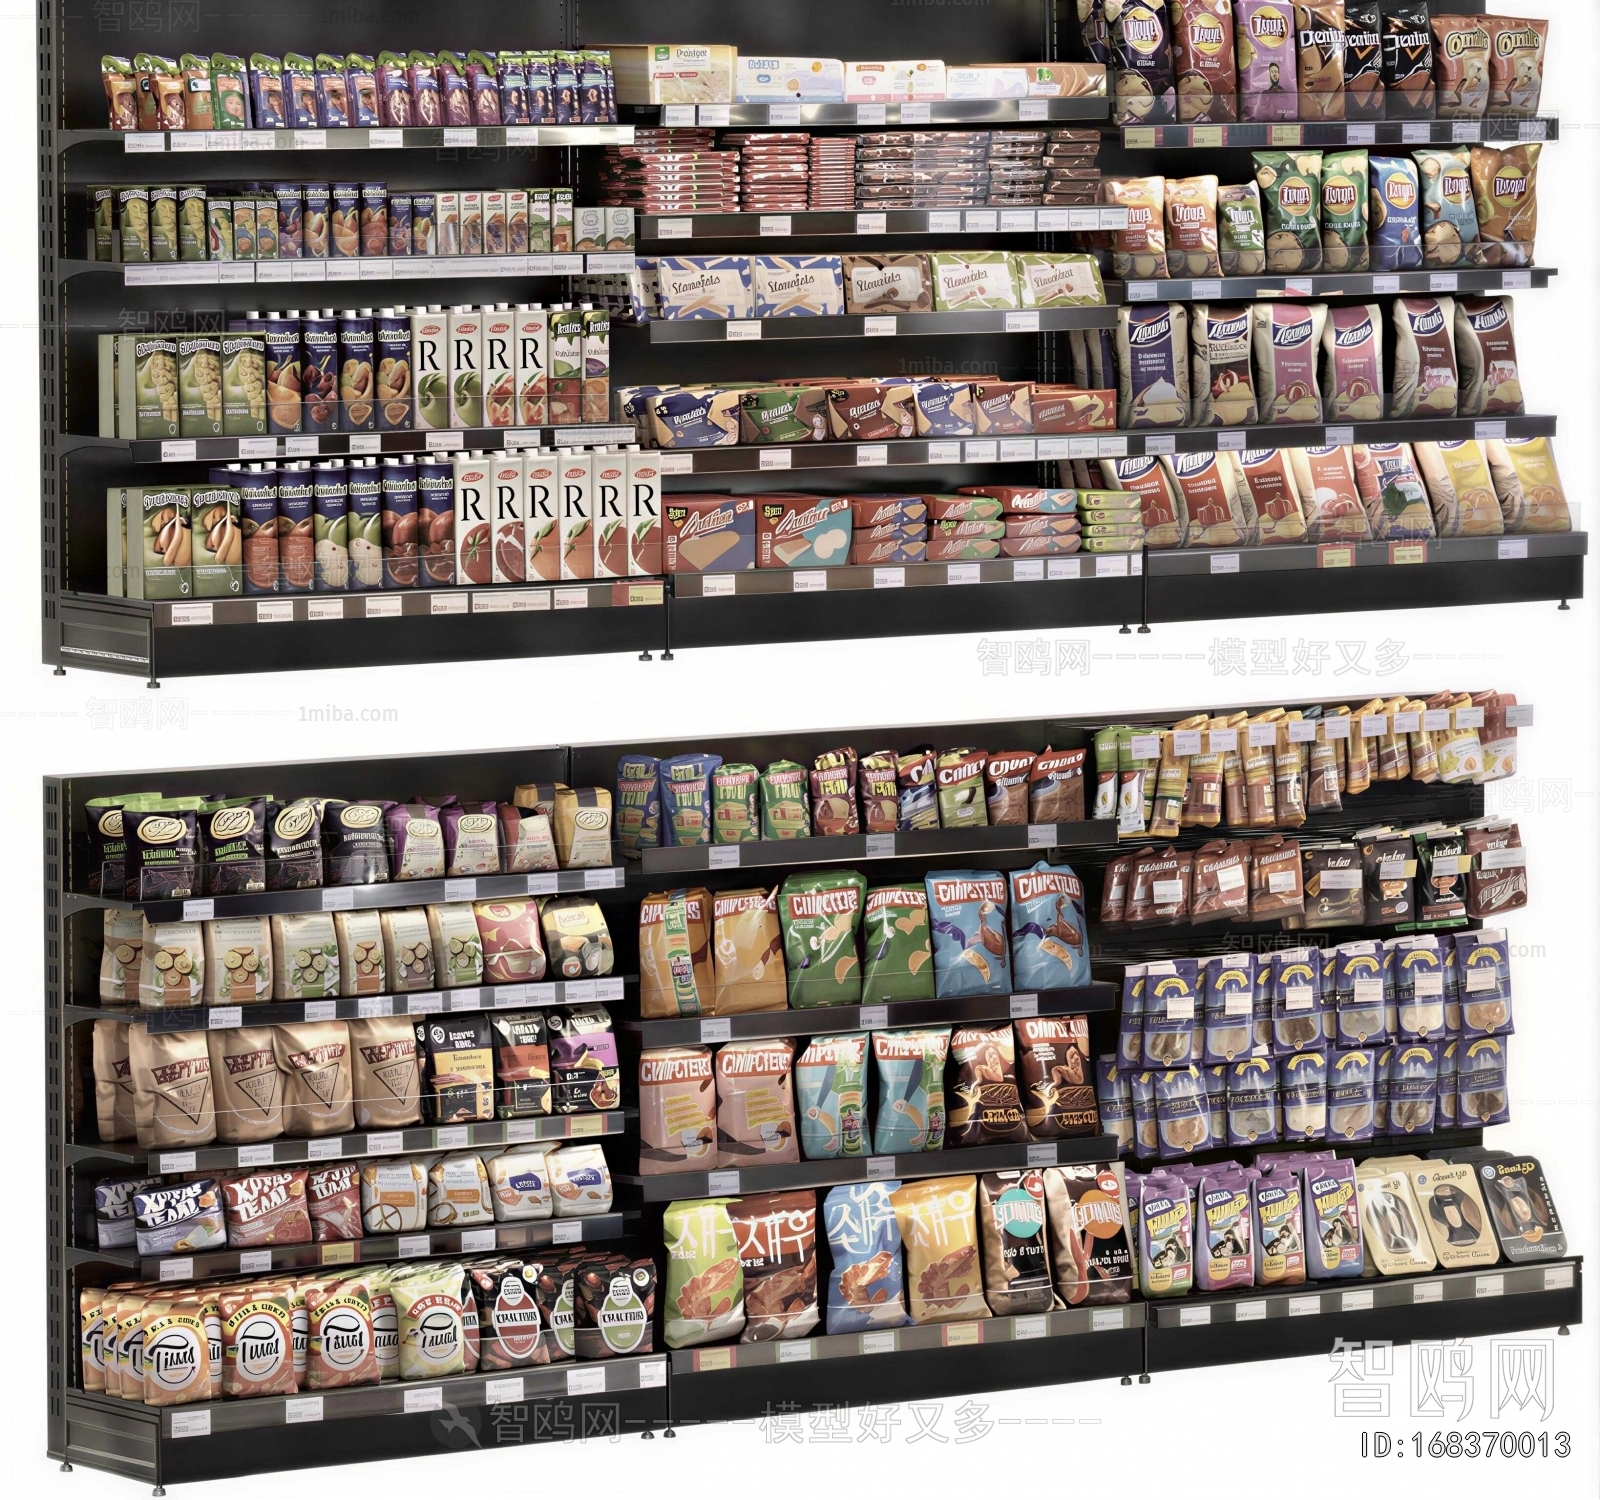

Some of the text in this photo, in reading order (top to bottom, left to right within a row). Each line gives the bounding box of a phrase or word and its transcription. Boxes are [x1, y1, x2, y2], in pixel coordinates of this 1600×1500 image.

[418, 340, 441, 372] R
[454, 339, 477, 370] R
[487, 338, 511, 370] R
[520, 338, 543, 369] R
[461, 488, 485, 522] R
[497, 486, 520, 519] R
[528, 485, 555, 518] R
[564, 485, 588, 518] R
[599, 485, 623, 517] R
[633, 484, 658, 516] R
